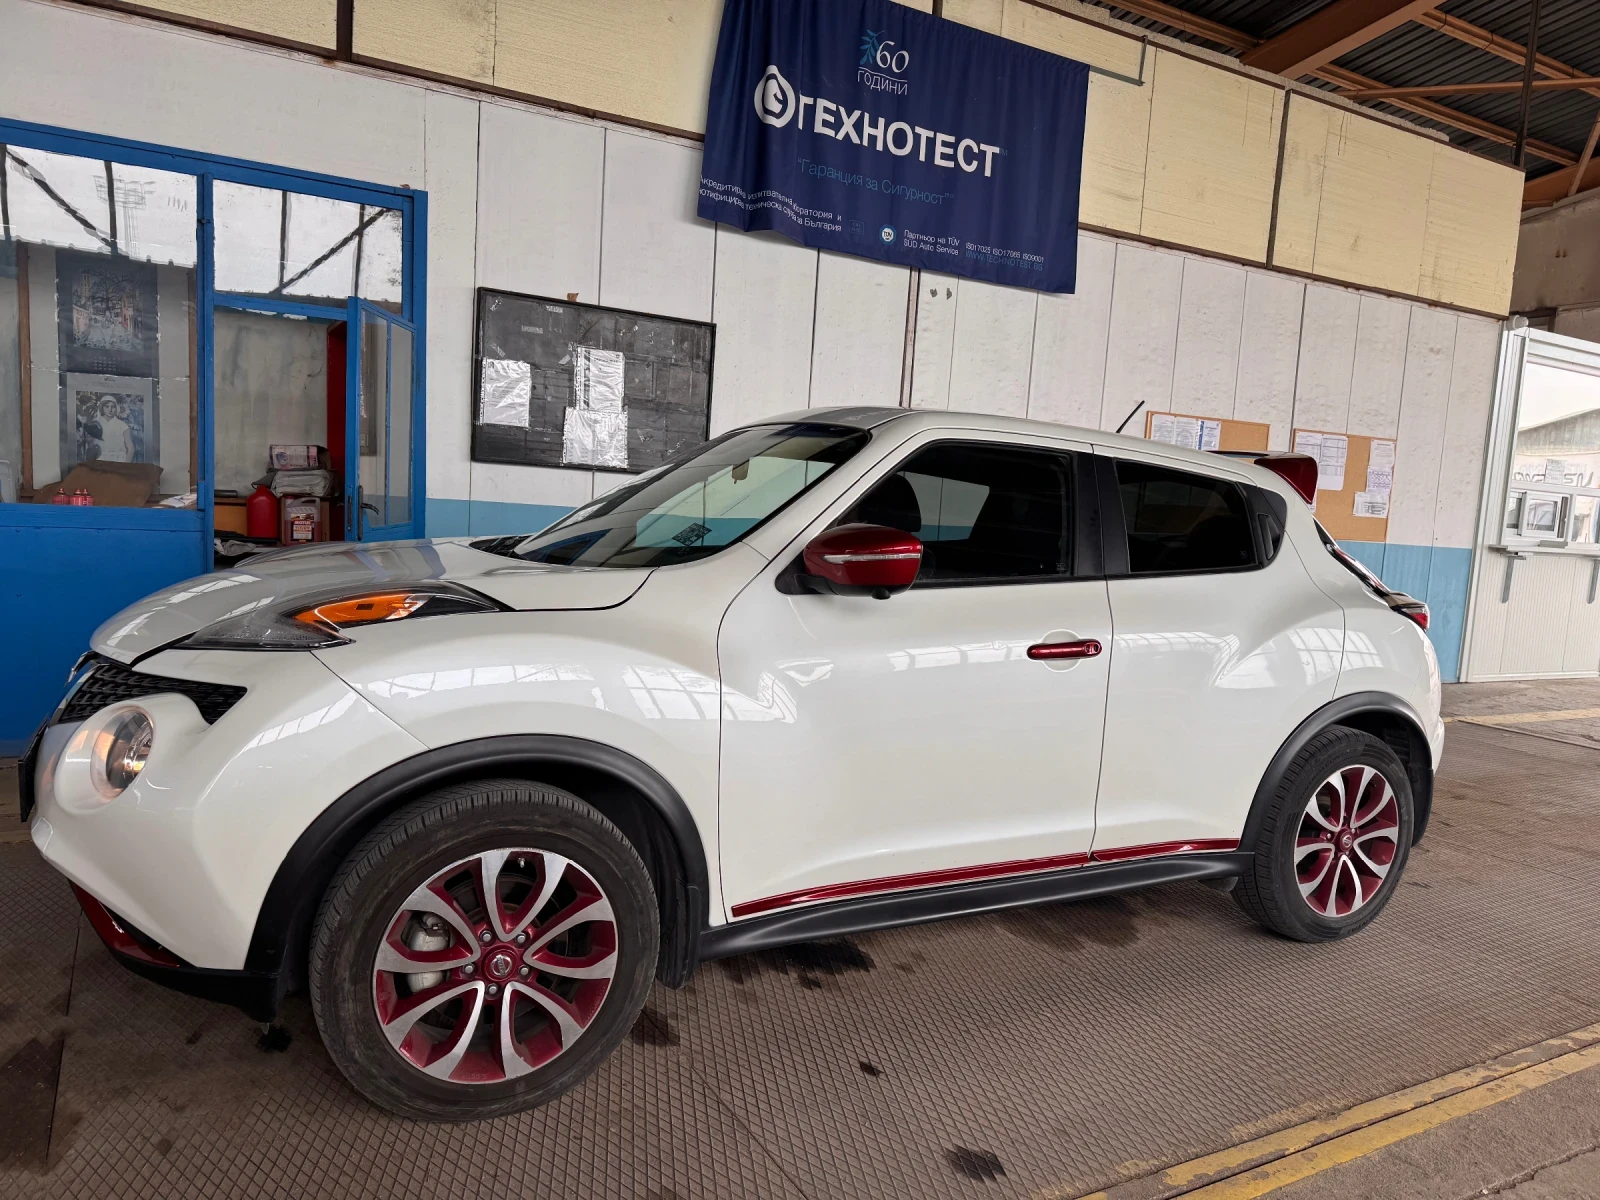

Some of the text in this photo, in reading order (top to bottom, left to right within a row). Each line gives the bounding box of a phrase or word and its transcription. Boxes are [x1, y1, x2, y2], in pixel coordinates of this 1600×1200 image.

[876, 40, 910, 73] 60
[857, 70, 909, 96] ГОДИНИ
[865, 178, 878, 191] за
[804, 217, 842, 232] България
[837, 214, 842, 222] и
[904, 229, 960, 247] Партньор на TÜV
[919, 242, 934, 252] Auto
[936, 244, 959, 256] Service
[965, 251, 1043, 272] WWW.TECHNOTEST.BG
